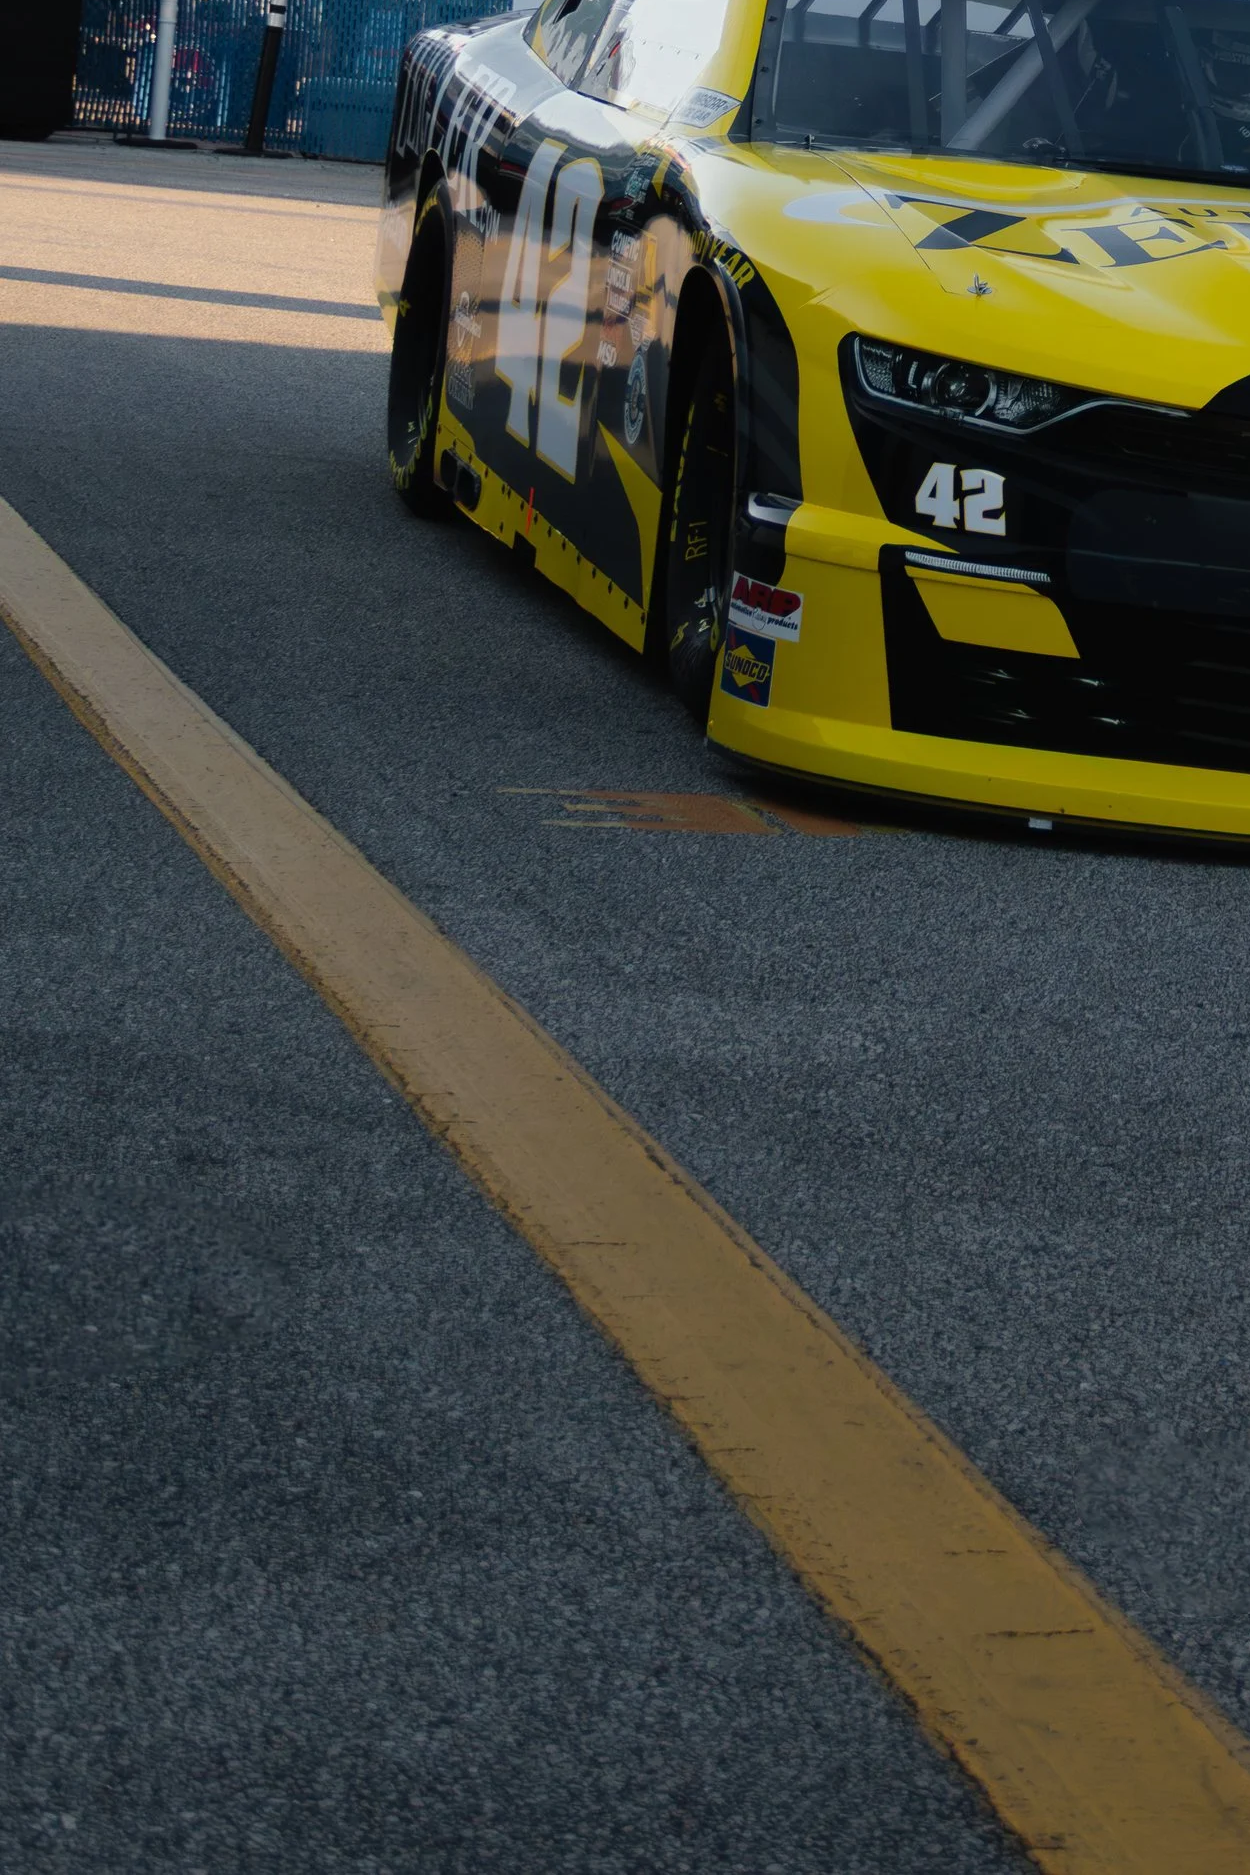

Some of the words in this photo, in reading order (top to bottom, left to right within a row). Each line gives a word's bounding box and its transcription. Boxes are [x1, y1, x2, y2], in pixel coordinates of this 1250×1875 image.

[495, 138, 605, 485] 42
[596, 340, 618, 368] MSD
[915, 462, 1006, 537] 42
[732, 575, 802, 618] ARP
[766, 615, 799, 631] products
[725, 651, 769, 681] SUNOCO
